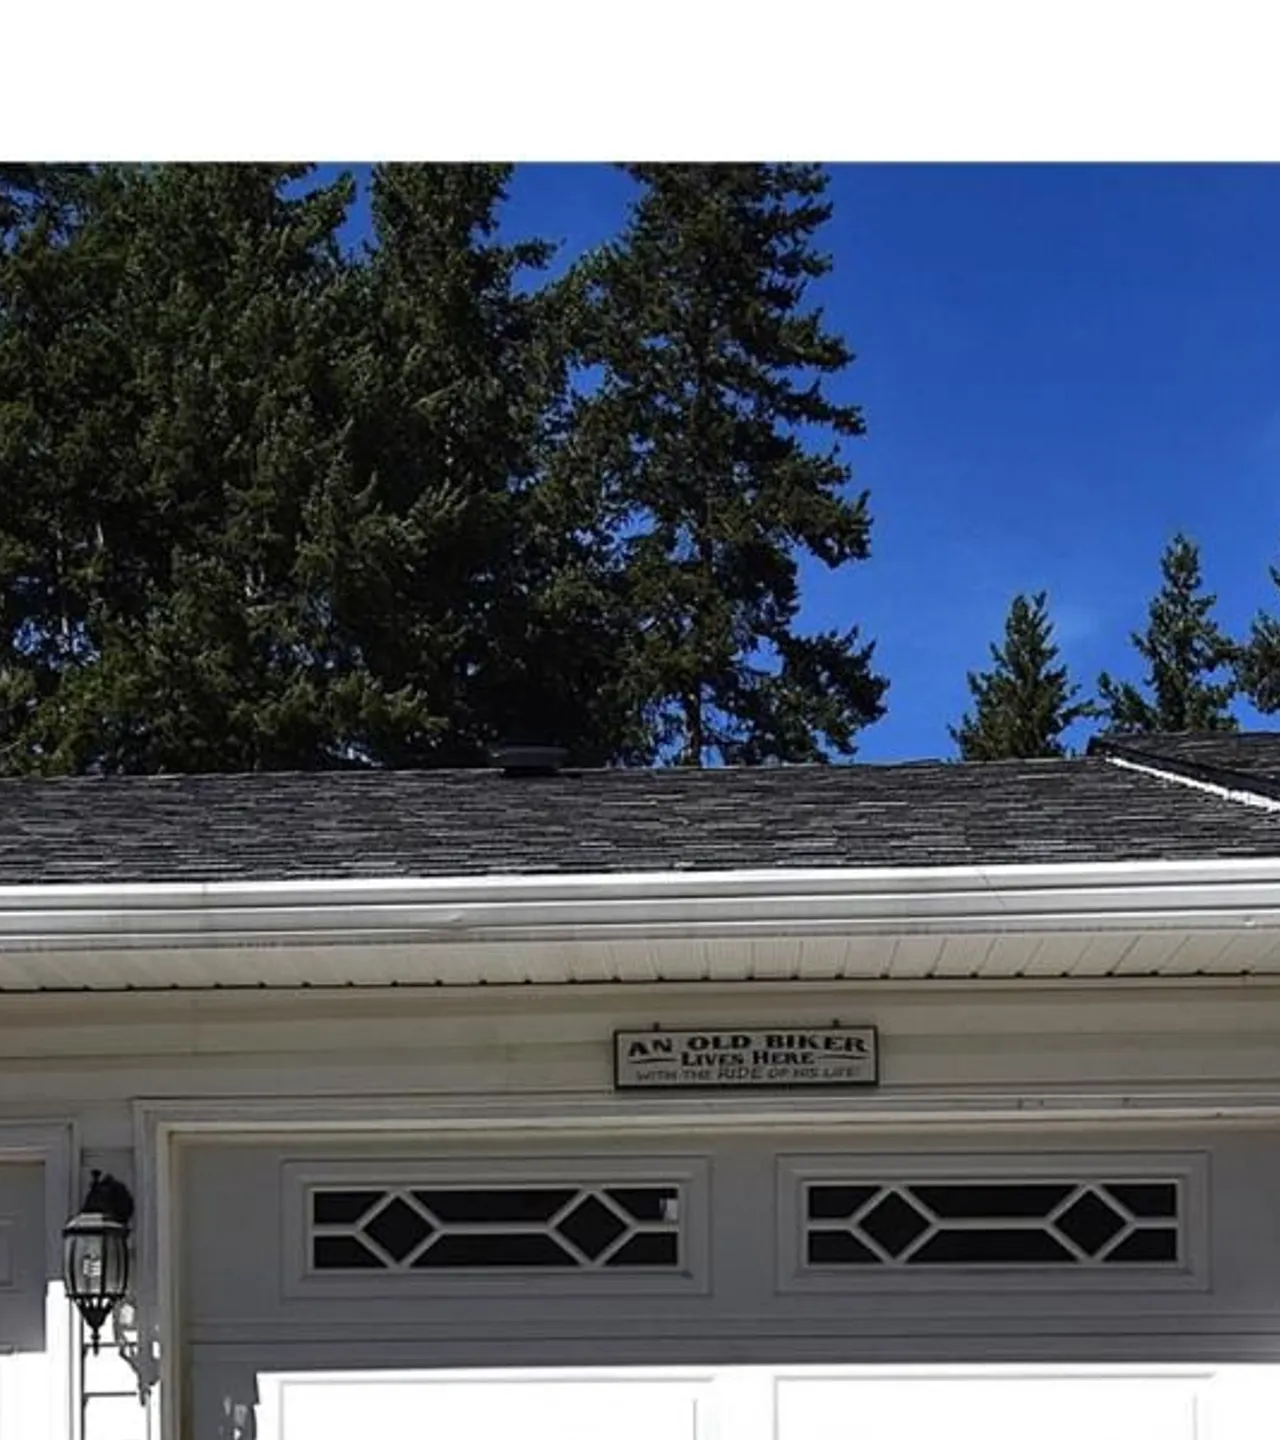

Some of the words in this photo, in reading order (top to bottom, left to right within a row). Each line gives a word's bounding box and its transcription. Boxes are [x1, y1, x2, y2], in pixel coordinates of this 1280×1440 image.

[629, 1038, 672, 1057] AN
[687, 1034, 752, 1050] OLD
[766, 1034, 869, 1052] BIKER
